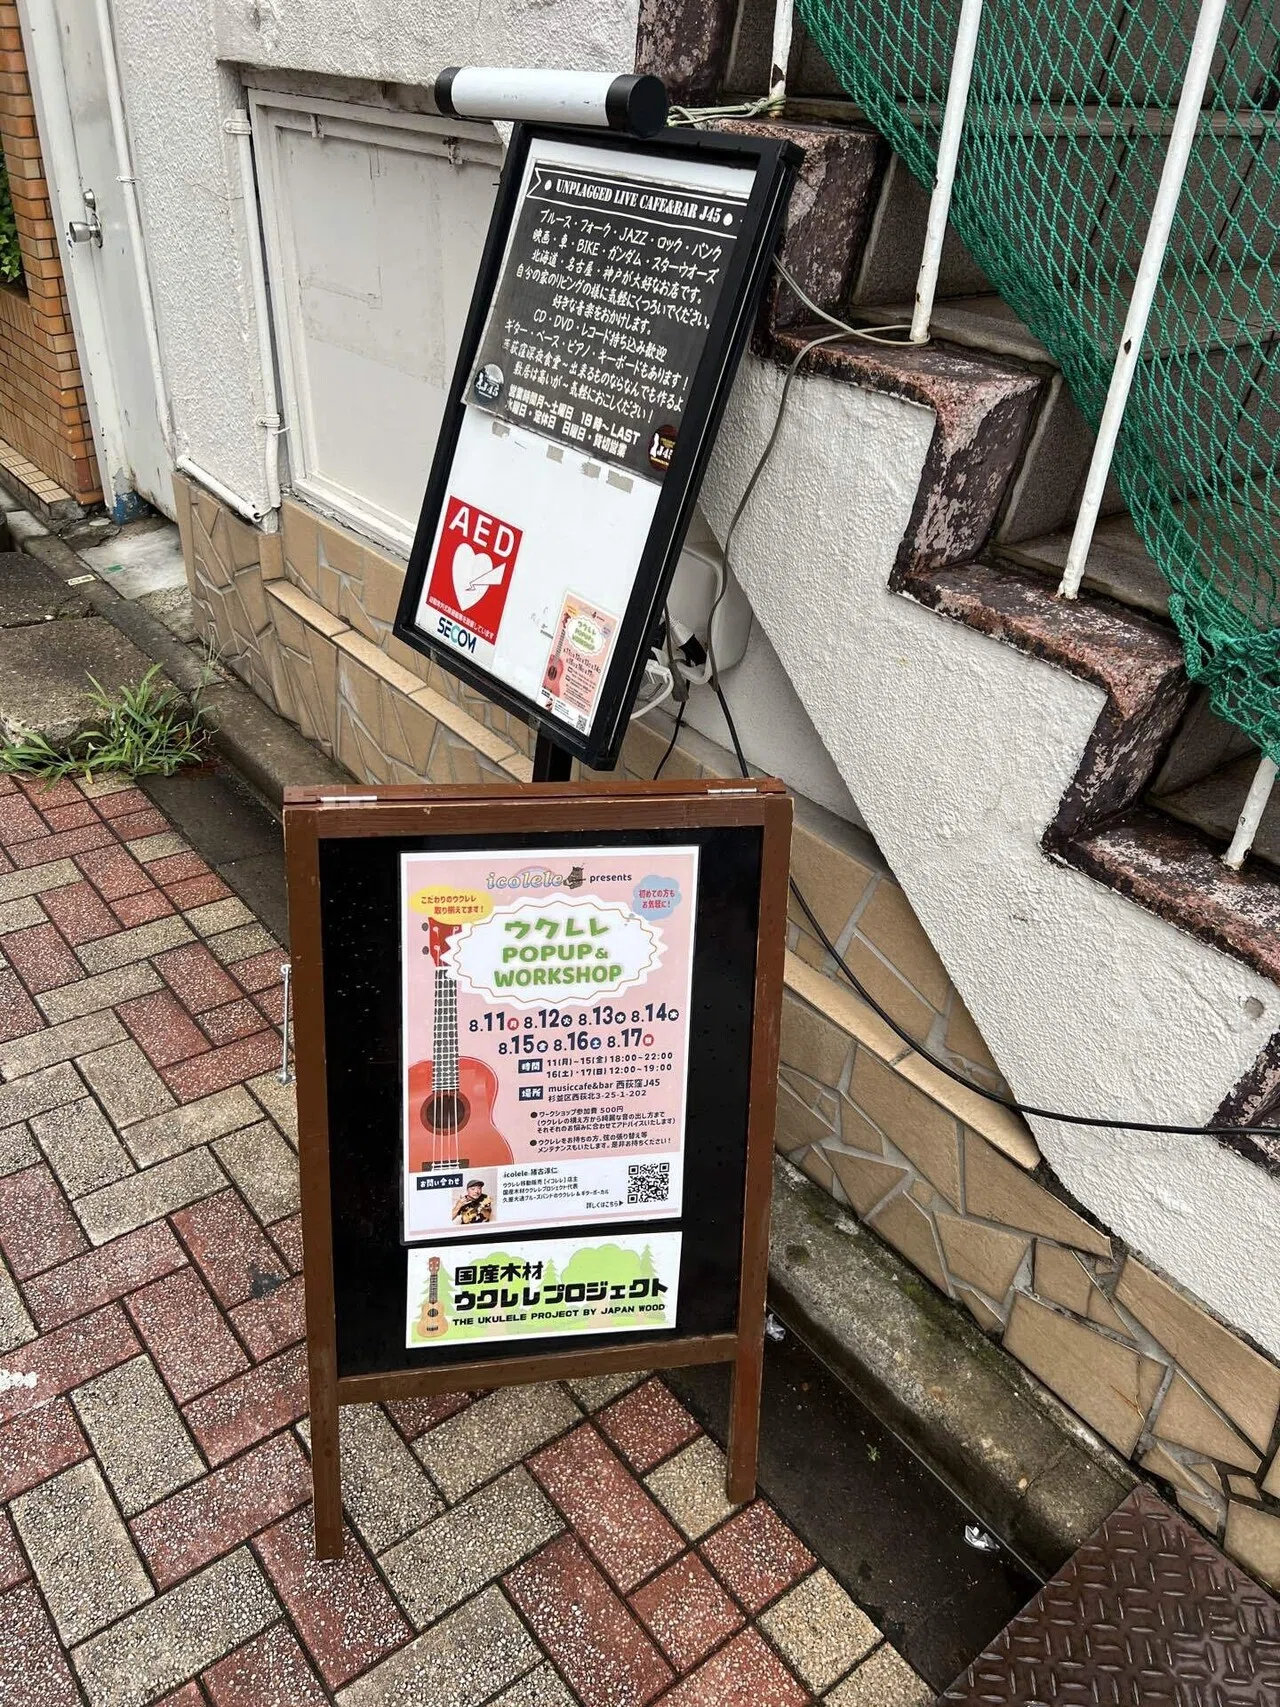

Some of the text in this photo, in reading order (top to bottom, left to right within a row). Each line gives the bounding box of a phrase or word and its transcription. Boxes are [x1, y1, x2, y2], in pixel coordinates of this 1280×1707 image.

[556, 179, 722, 223] UNPLAGGED LIVE CAFE&BAR J45
[448, 506, 515, 558] AED
[437, 616, 477, 654] SECOM
[485, 871, 632, 890] icolele presents
[420, 895, 477, 905] こだわりのウクレレ
[638, 889, 675, 899] 初めての方も
[504, 917, 609, 940] ウクレレ
[493, 964, 623, 988] WORKSHOP
[521, 1061, 541, 1072] 時間
[521, 1088, 541, 1098] 場所
[548, 1081, 614, 1093] musiccafe&bar
[600, 1105, 624, 1114] 500円
[420, 1177, 460, 1188] お問い合わせ
[503, 1170, 528, 1178] icolele
[454, 1260, 544, 1286] 国産木材
[454, 1277, 668, 1311] ウクレレプロジェクト
[453, 1303, 665, 1326] THE UKULELE PROJECT BY JAPAN WOOD
